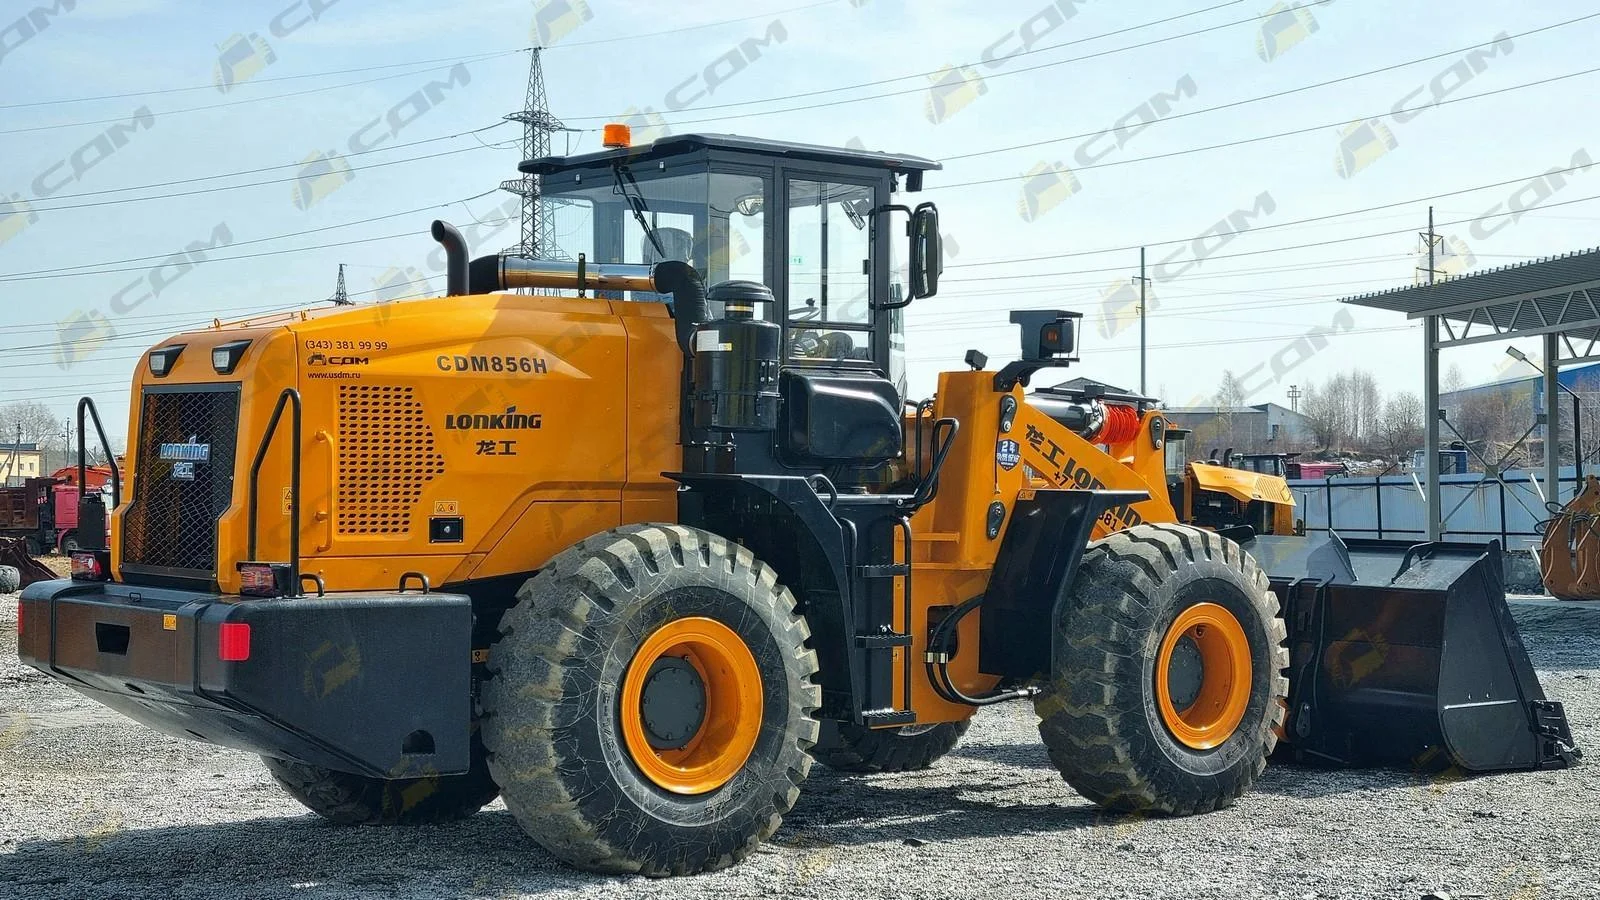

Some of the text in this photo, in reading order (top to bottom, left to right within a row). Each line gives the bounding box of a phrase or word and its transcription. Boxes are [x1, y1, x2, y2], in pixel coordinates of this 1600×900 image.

[305, 340, 388, 350] (343) 381 99 99
[436, 355, 548, 374] CDM856H
[307, 371, 361, 379] www.usdm.ru
